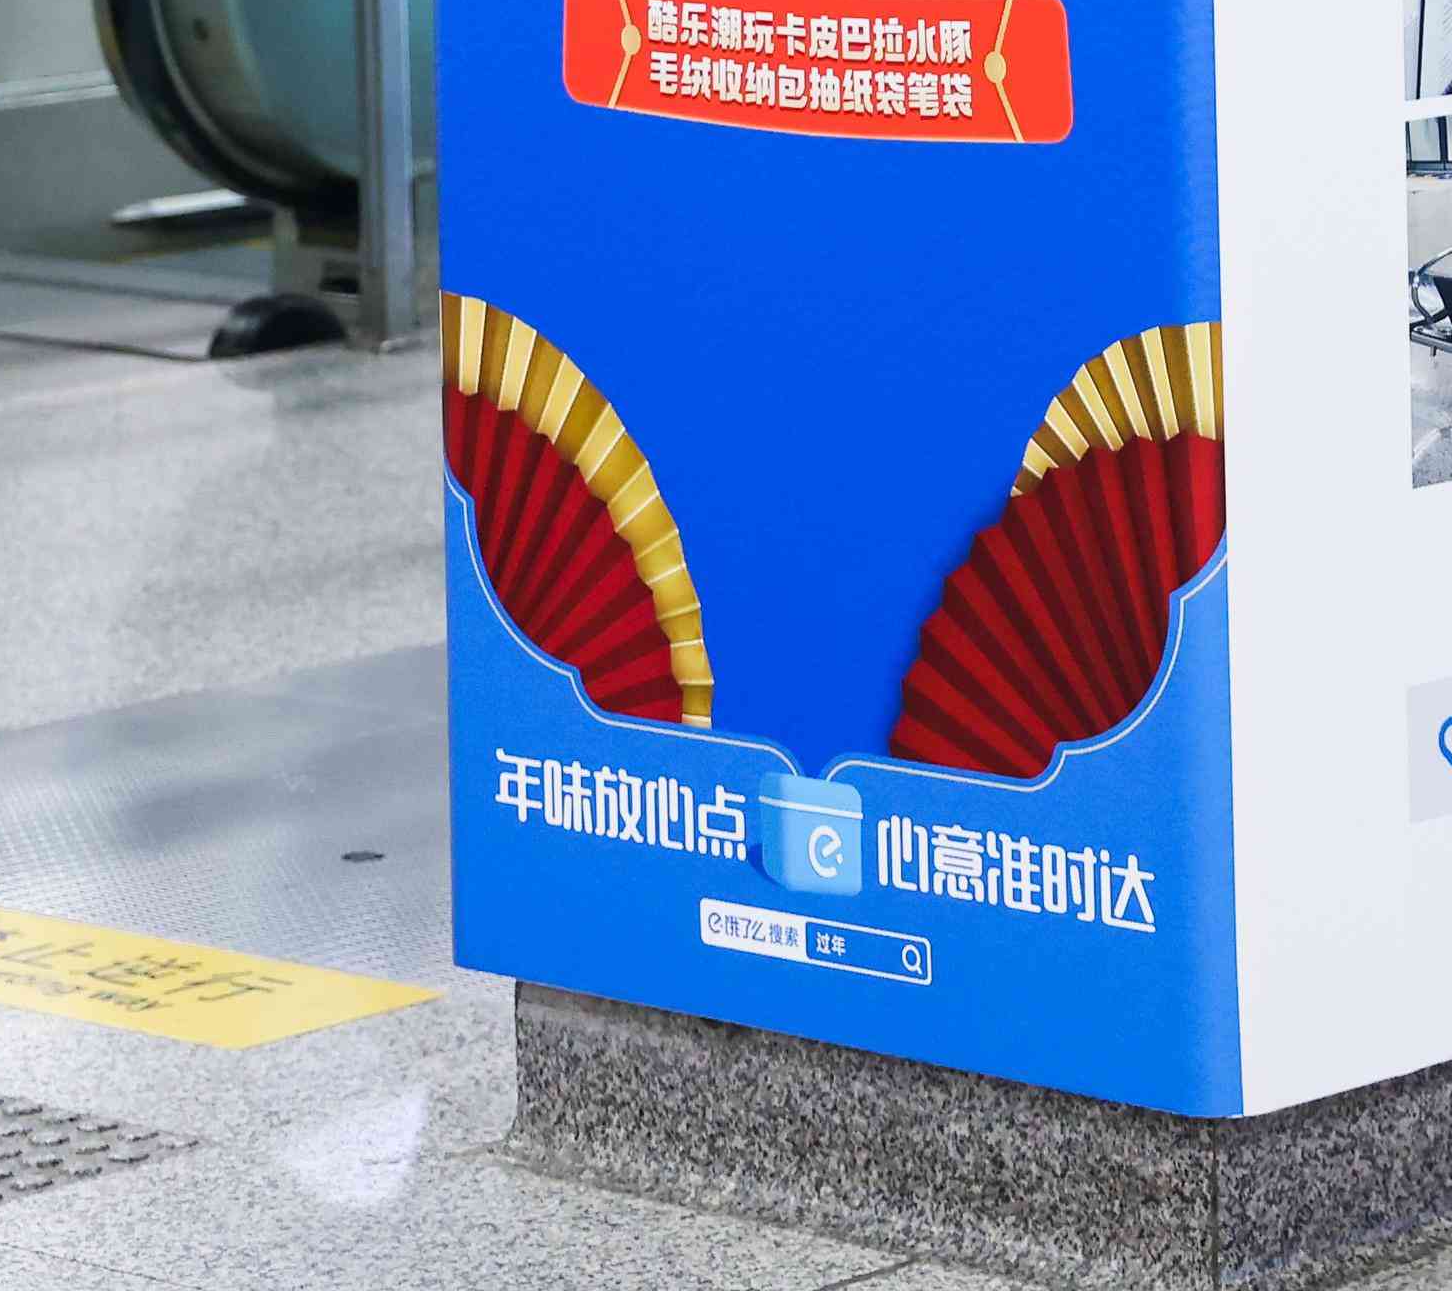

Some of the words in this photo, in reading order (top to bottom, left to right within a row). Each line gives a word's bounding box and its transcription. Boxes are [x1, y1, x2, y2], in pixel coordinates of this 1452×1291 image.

[649, 52, 973, 119] 毛绒收纳包抽纸袋笔袋
[494, 747, 747, 861] 年味放心点
[877, 815, 1156, 933] 心意准时达
[816, 931, 846, 956] 过年
